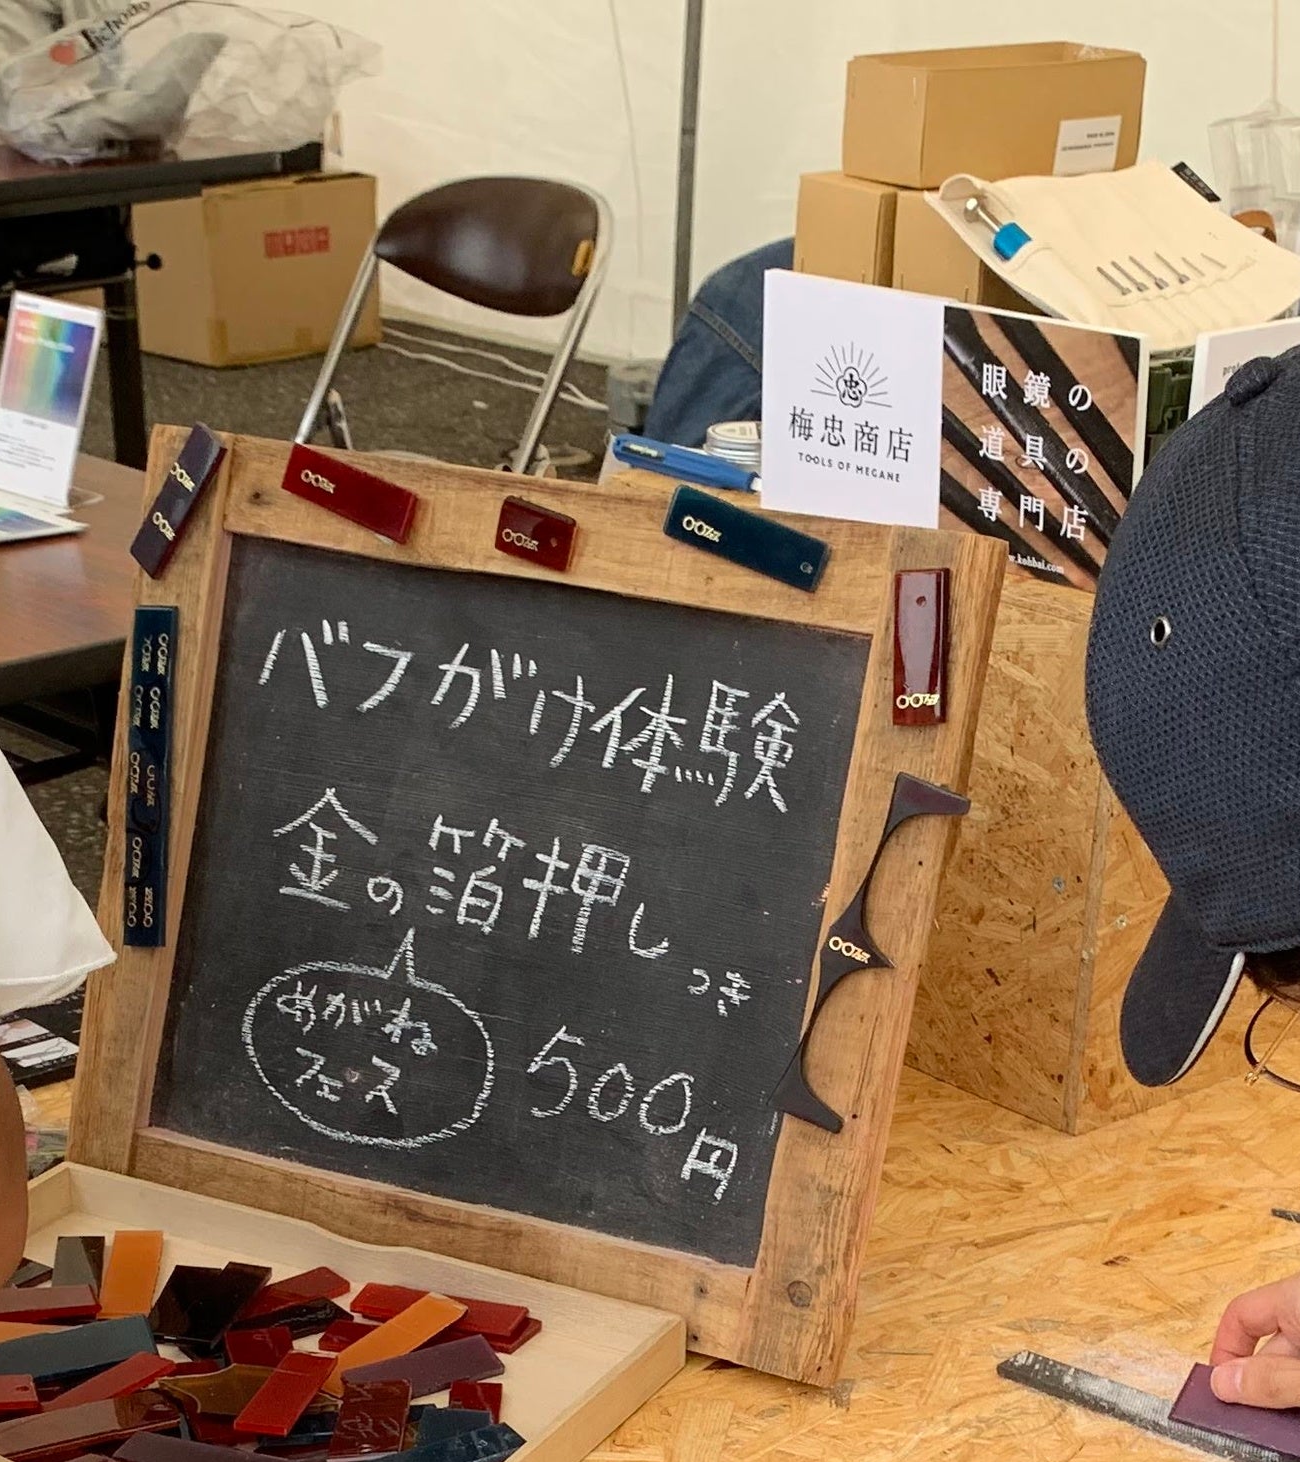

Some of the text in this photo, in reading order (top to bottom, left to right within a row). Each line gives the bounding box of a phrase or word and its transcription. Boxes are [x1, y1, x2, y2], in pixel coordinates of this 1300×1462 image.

[842, 373, 863, 401] 忠
[982, 362, 1092, 412] 眼鏡の
[788, 405, 914, 463] 梅忠商店
[978, 425, 1089, 475] 道具の
[798, 452, 901, 483] TOOLS OF MEGANE
[977, 486, 1089, 542] 専門店
[257, 618, 801, 814] バフがけ体験
[272, 787, 671, 959] 金の箔押し
[276, 981, 438, 1056] めがね
[295, 1046, 402, 1115] フェス
